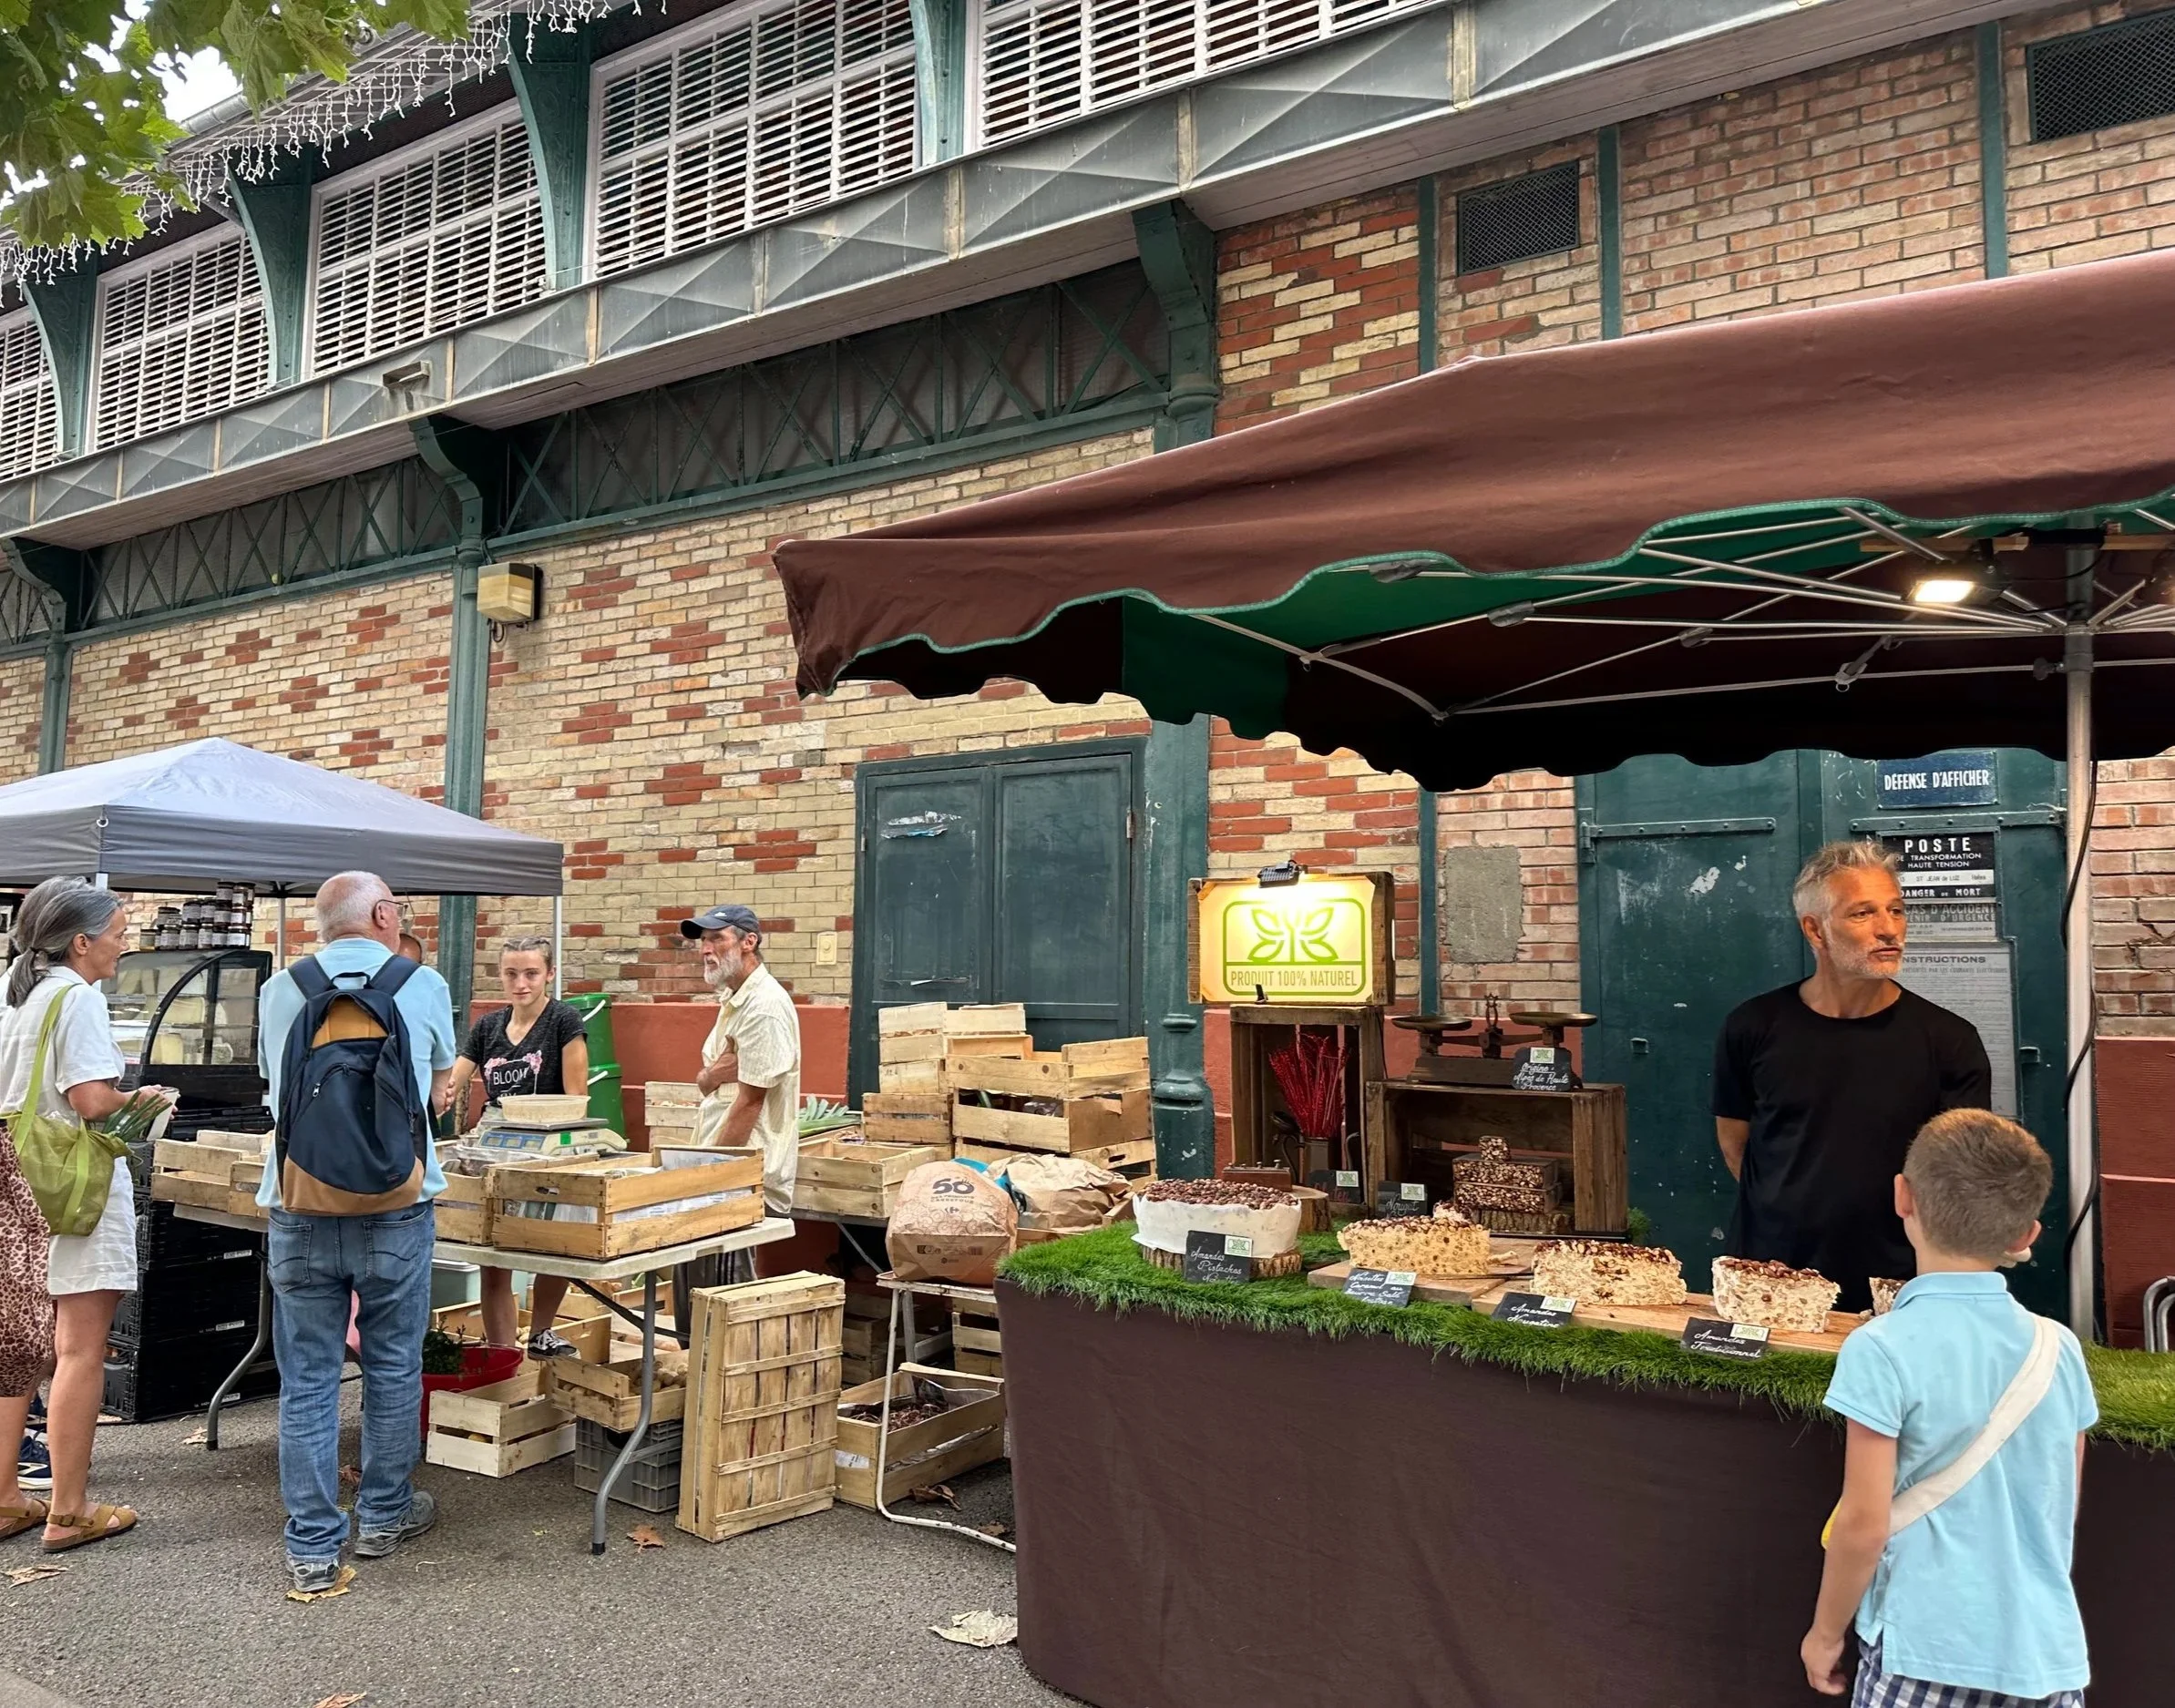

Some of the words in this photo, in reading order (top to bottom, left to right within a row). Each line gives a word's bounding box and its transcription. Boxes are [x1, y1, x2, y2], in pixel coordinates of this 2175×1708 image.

[1883, 772, 1927, 791] DÉFENSE
[1932, 769, 1989, 789] D'AFFICHER
[1904, 837, 1971, 854] POSTE
[1911, 853, 1982, 861] TRANSFORMATION
[1900, 889, 1935, 897] DANGER
[1955, 888, 1981, 896] MORT
[1904, 905, 1925, 915] CAS
[1931, 904, 1995, 915] D'ACCIDENT
[1940, 914, 1995, 922] D'URGENCE
[1902, 956, 1986, 964] NSTRUCTIONS
[1231, 971, 1274, 986] PRODUIT
[1278, 970, 1307, 987] 100%
[1310, 970, 1357, 987] NATUREL
[493, 1069, 529, 1085] BLOOM
[1191, 1246, 1225, 1261] Amandes
[1197, 1260, 1242, 1274] Pistaches
[1511, 1303, 1556, 1316] Amandes
[1695, 1330, 1746, 1344] Amandes
